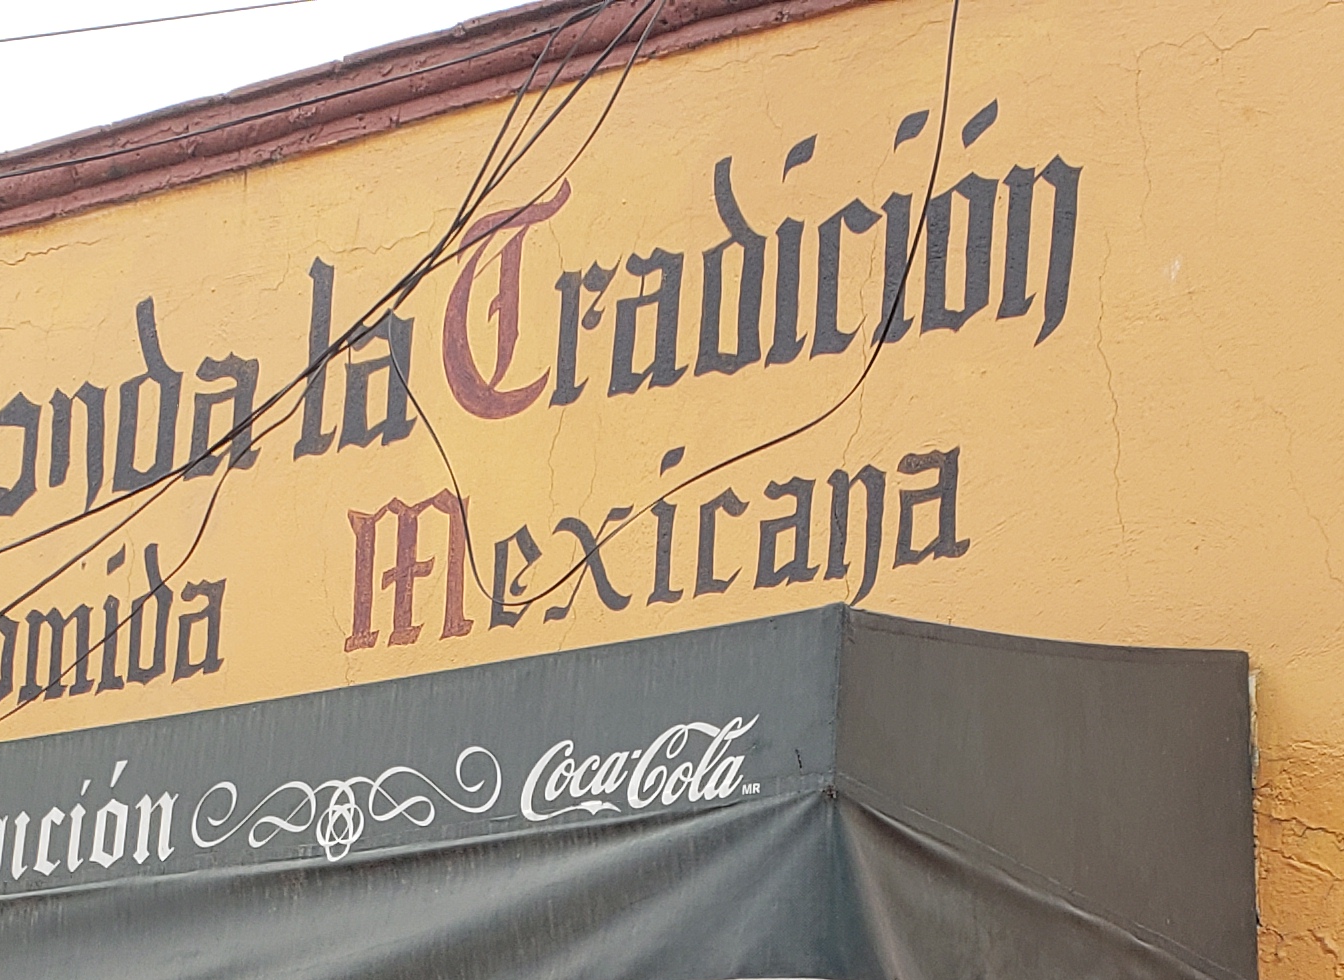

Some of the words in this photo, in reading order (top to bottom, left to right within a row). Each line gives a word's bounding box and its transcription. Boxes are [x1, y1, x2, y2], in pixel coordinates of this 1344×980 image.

[293, 257, 417, 462] la
[441, 99, 1083, 421] Tradición
[344, 446, 970, 652] Mexicana
[521, 714, 760, 822] Coca-Cola
